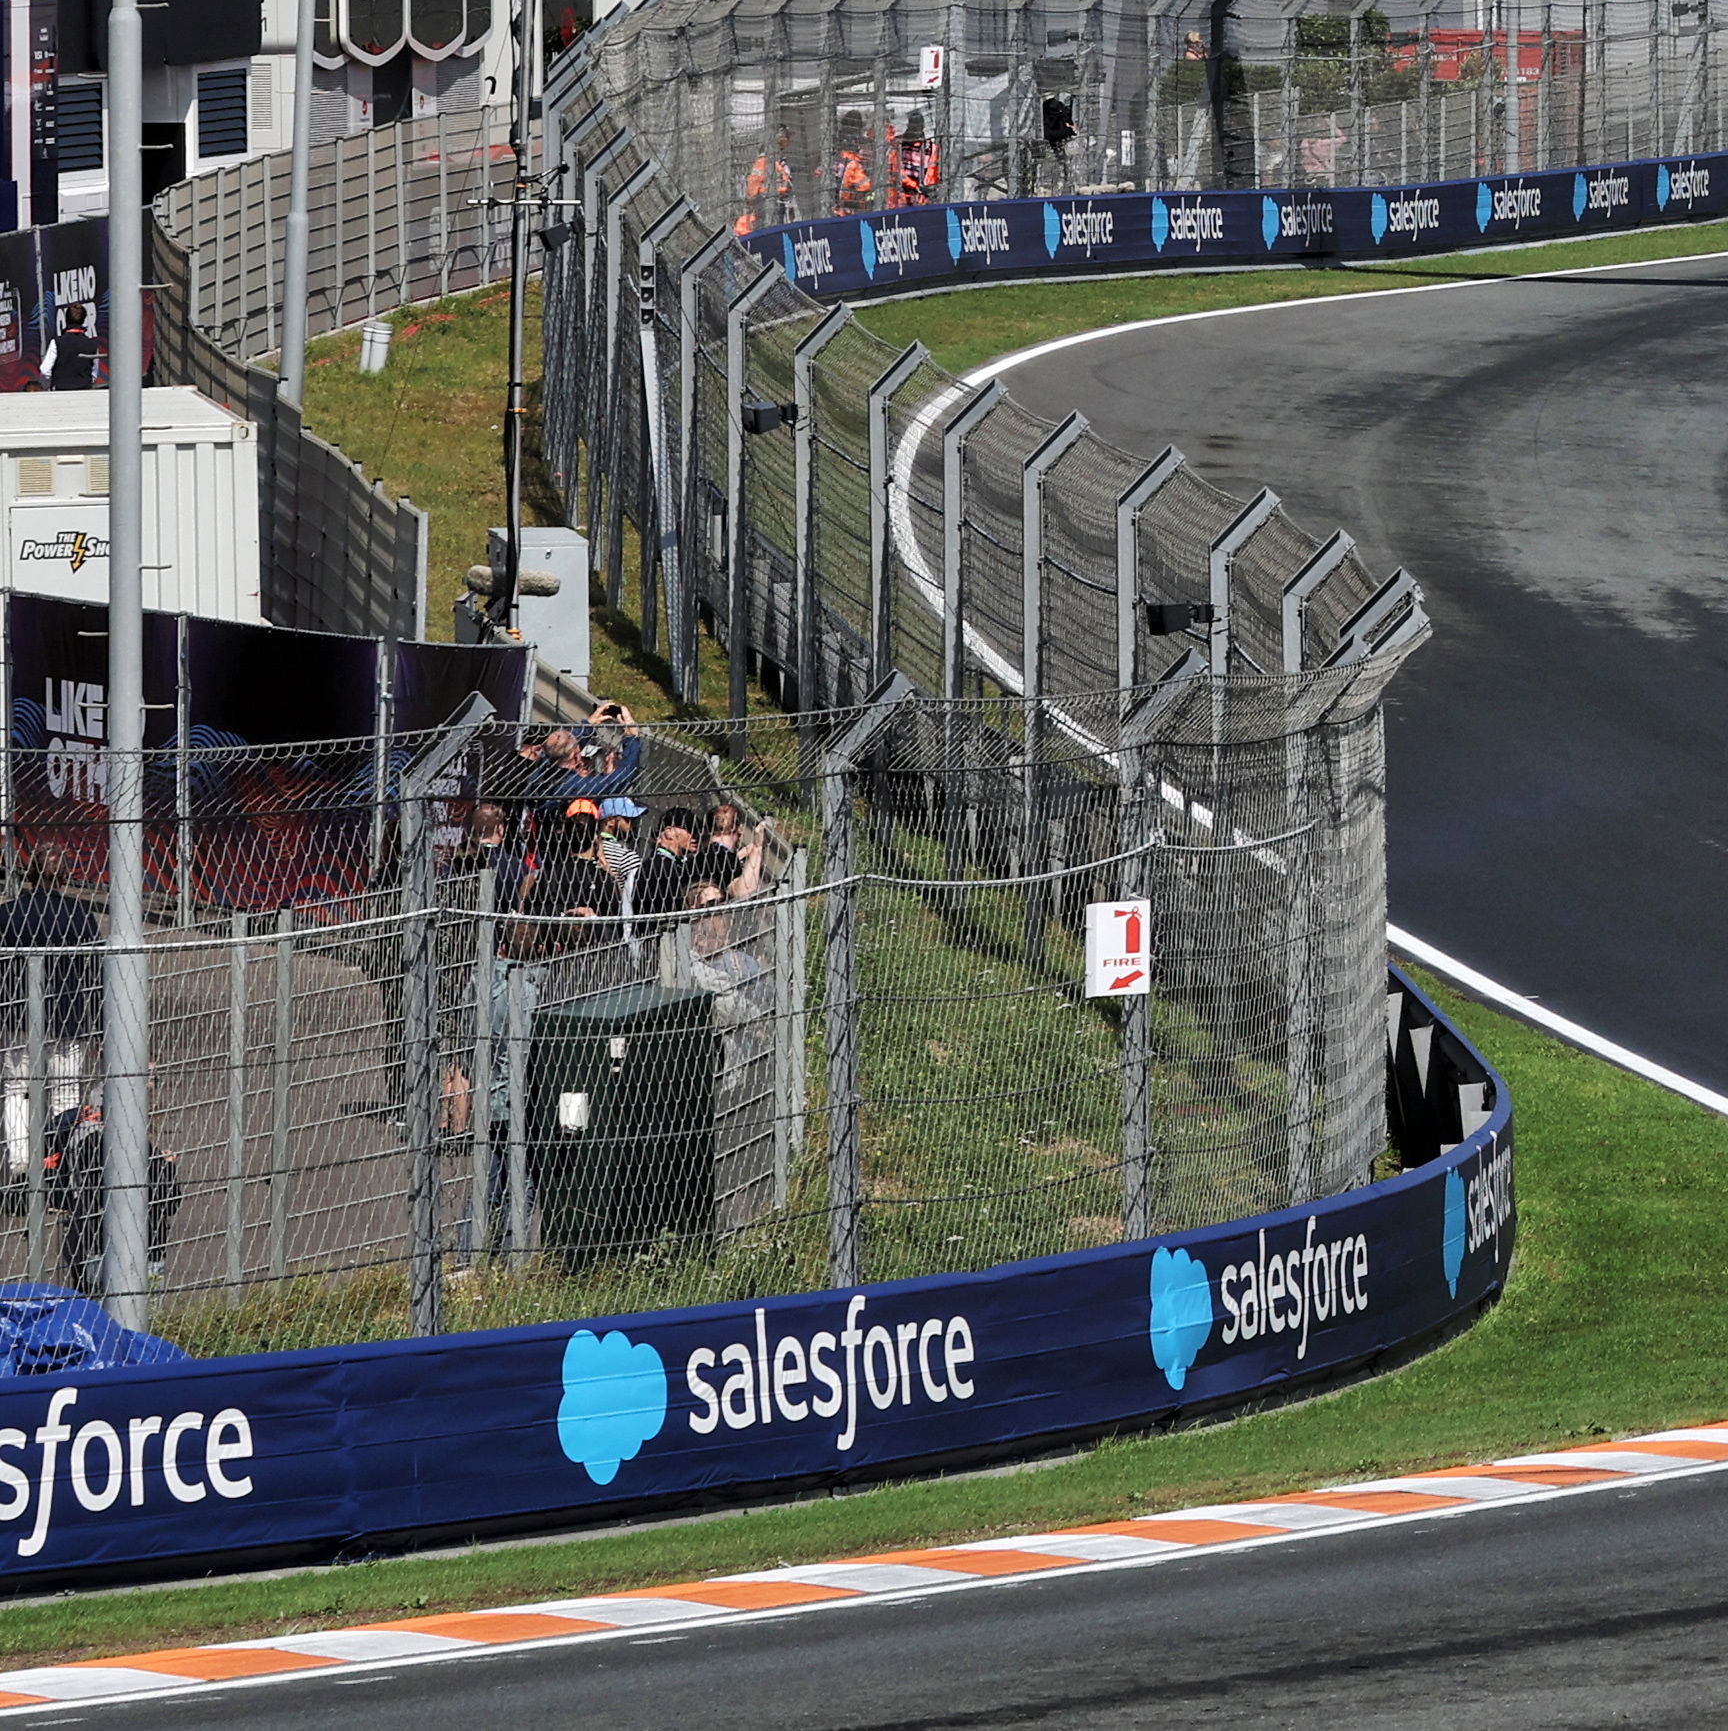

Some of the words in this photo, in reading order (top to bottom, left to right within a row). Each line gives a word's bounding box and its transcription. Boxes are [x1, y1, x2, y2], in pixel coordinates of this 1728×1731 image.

[1494, 178, 1541, 230] salesforce
[1588, 168, 1629, 218] salesforce
[1670, 160, 1710, 209] salesforce
[962, 206, 1009, 265] salesforce
[1062, 199, 1113, 258] salesforce
[1170, 195, 1223, 252] salesforce
[1281, 191, 1333, 246] salesforce
[1389, 189, 1439, 241] salesforce
[795, 227, 834, 289] salesforce
[876, 216, 919, 274] salesforce
[54, 269, 78, 306] LIKE
[78, 265, 96, 301] NO
[58, 532, 77, 543] THE
[46, 677, 104, 739] LIKE
[1103, 957, 1142, 967] FIRE
[1220, 1215, 1369, 1358] salesforce
[687, 1295, 975, 1452] salesforce
